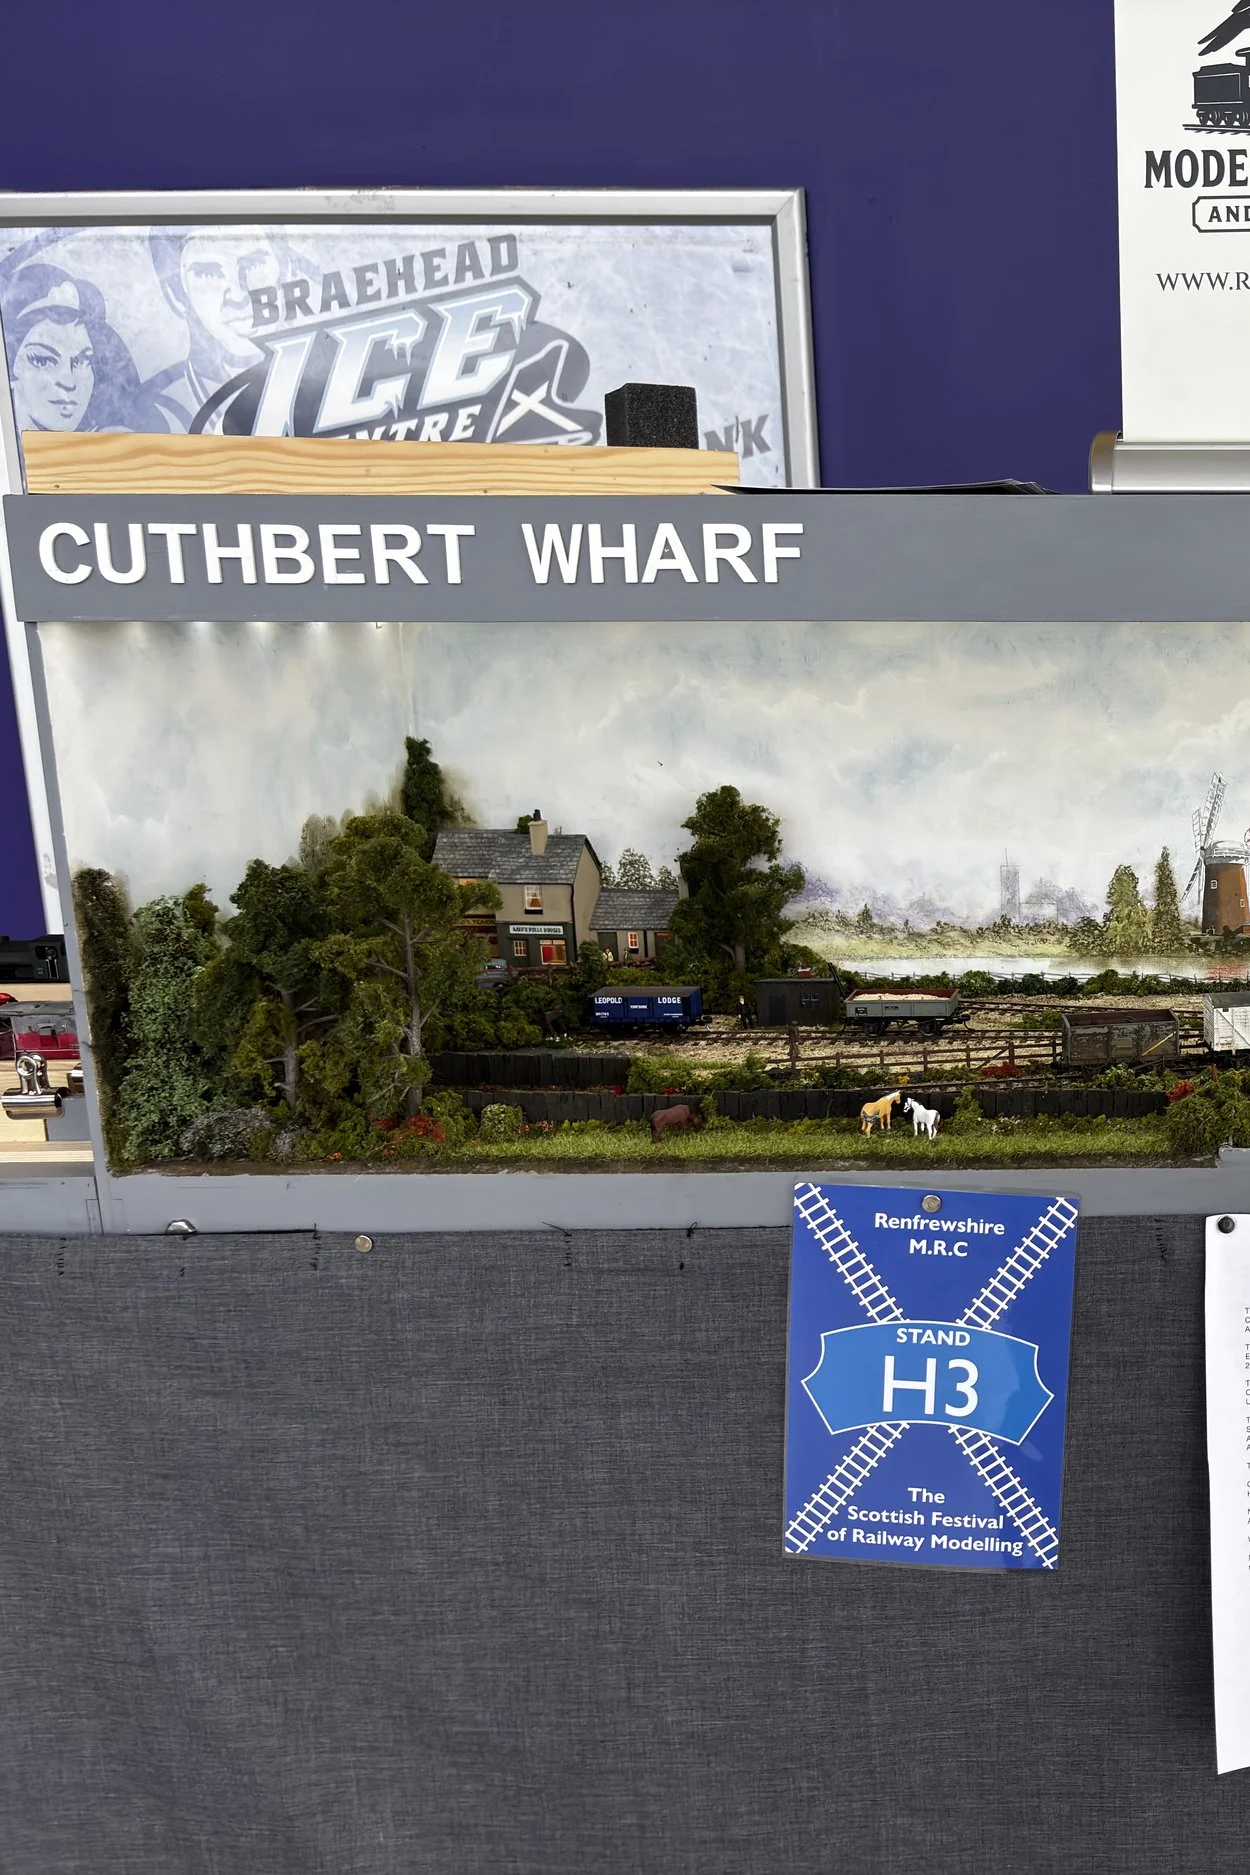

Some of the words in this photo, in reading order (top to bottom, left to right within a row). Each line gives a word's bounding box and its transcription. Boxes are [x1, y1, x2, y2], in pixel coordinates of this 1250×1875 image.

[250, 234, 519, 328] BRAEHEAD
[251, 283, 535, 437] ICE
[37, 522, 475, 587] CUTHBERT
[521, 522, 805, 585] WHARF
[874, 1212, 1005, 1235] Renfrewshire
[909, 1238, 969, 1257] M.R.C
[896, 1328, 971, 1346] STAND
[882, 1355, 979, 1417] H3
[907, 1487, 946, 1504] The
[847, 1505, 925, 1525] Scottish
[931, 1511, 1004, 1529] Festival
[827, 1527, 847, 1542] of
[852, 1528, 925, 1552] Railway
[930, 1534, 1024, 1557] Modelling
